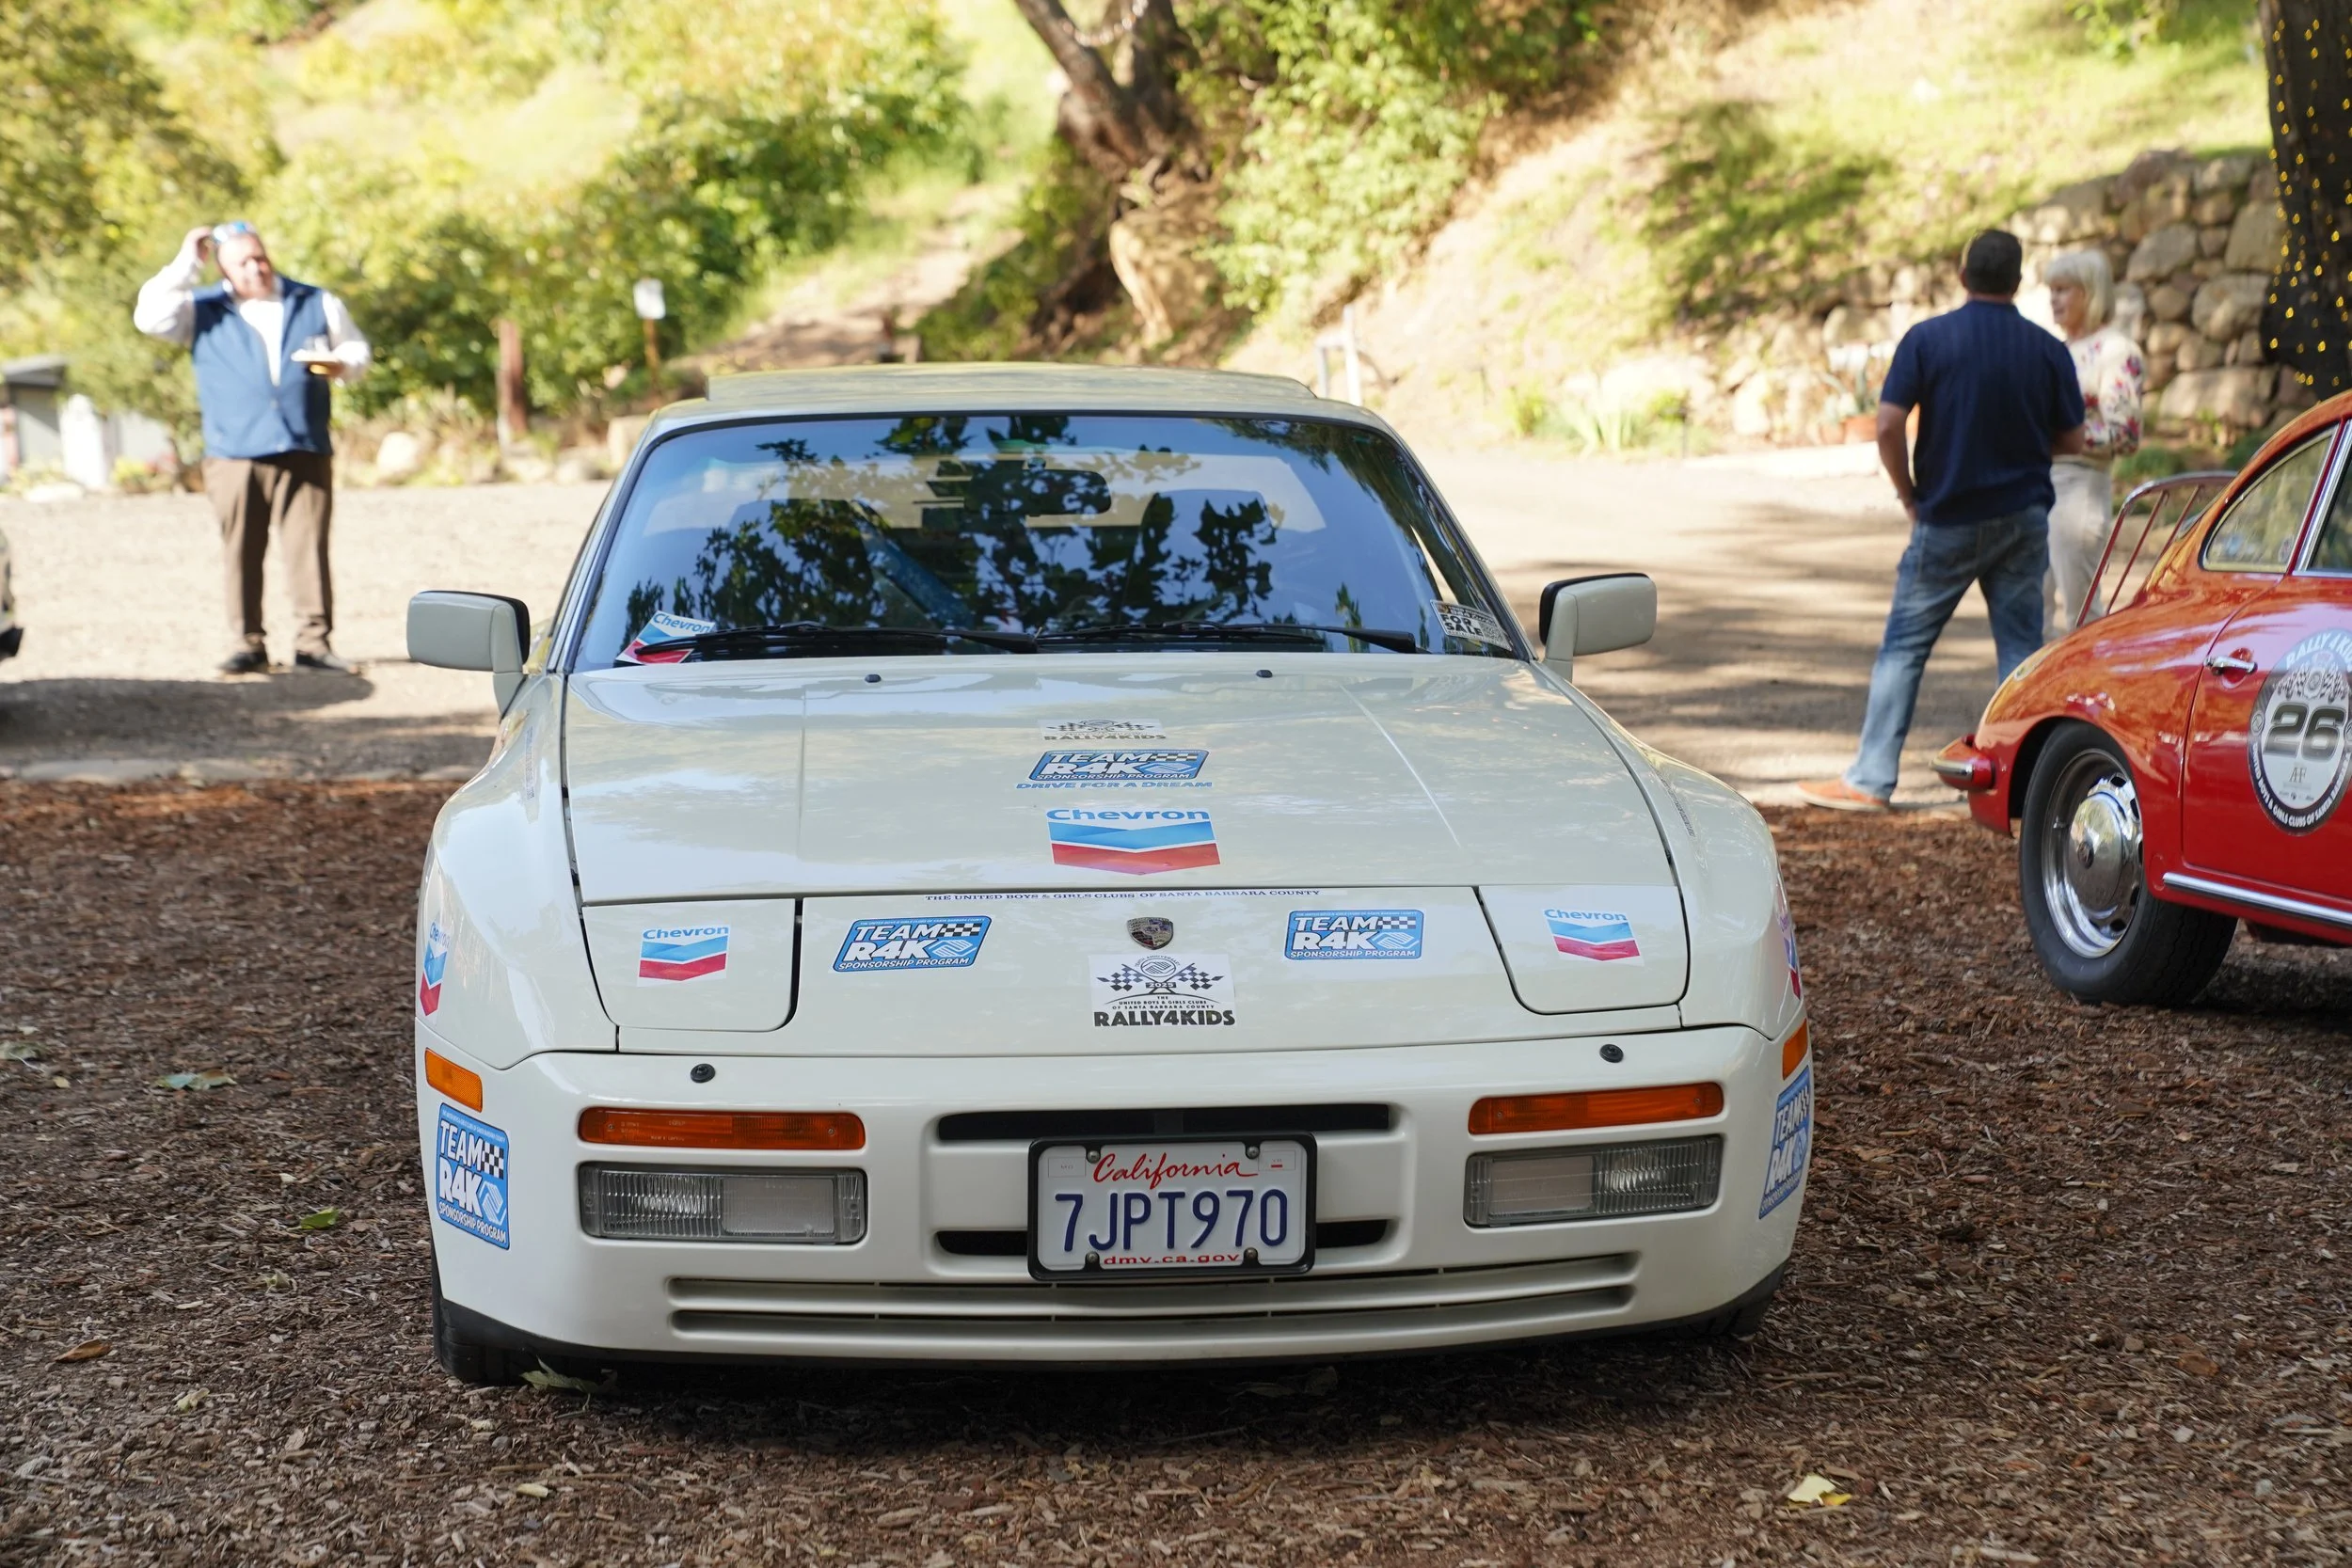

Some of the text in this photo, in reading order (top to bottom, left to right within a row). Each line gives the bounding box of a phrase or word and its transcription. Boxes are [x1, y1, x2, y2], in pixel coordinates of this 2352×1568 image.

[654, 613, 710, 633] Chevron
[1439, 614, 1471, 626] FOR
[1445, 623, 1484, 637] SALE
[2286, 633, 2331, 670] RALLY
[2263, 702, 2347, 762] 26
[1049, 752, 1153, 763] TEAM
[1040, 762, 1147, 775] R4K
[1046, 809, 1210, 821] Chevron
[2273, 805, 2288, 824] GIRLS
[2288, 816, 2306, 828] CLUBS
[2306, 814, 2315, 825] OF
[1295, 915, 1379, 931] TEAM
[1544, 909, 1628, 921] Chevron
[644, 926, 729, 940] Chevron
[855, 924, 944, 942] TEAM
[1292, 931, 1377, 950] R4K
[843, 939, 938, 962] R4K
[838, 958, 969, 970] SPONSORSHIP PROGRAM
[1094, 1010, 1235, 1026] RALLY4KIDS
[1775, 1094, 1804, 1147] TEAM
[440, 1119, 483, 1172] TEAM
[1093, 1152, 1259, 1190] California
[438, 1157, 483, 1217] R4K
[438, 1201, 506, 1243] SPONSORSHIP PROGRAM
[1055, 1189, 1288, 1252] 7JPT970
[1104, 1253, 1239, 1265] dmv.ca.gov
